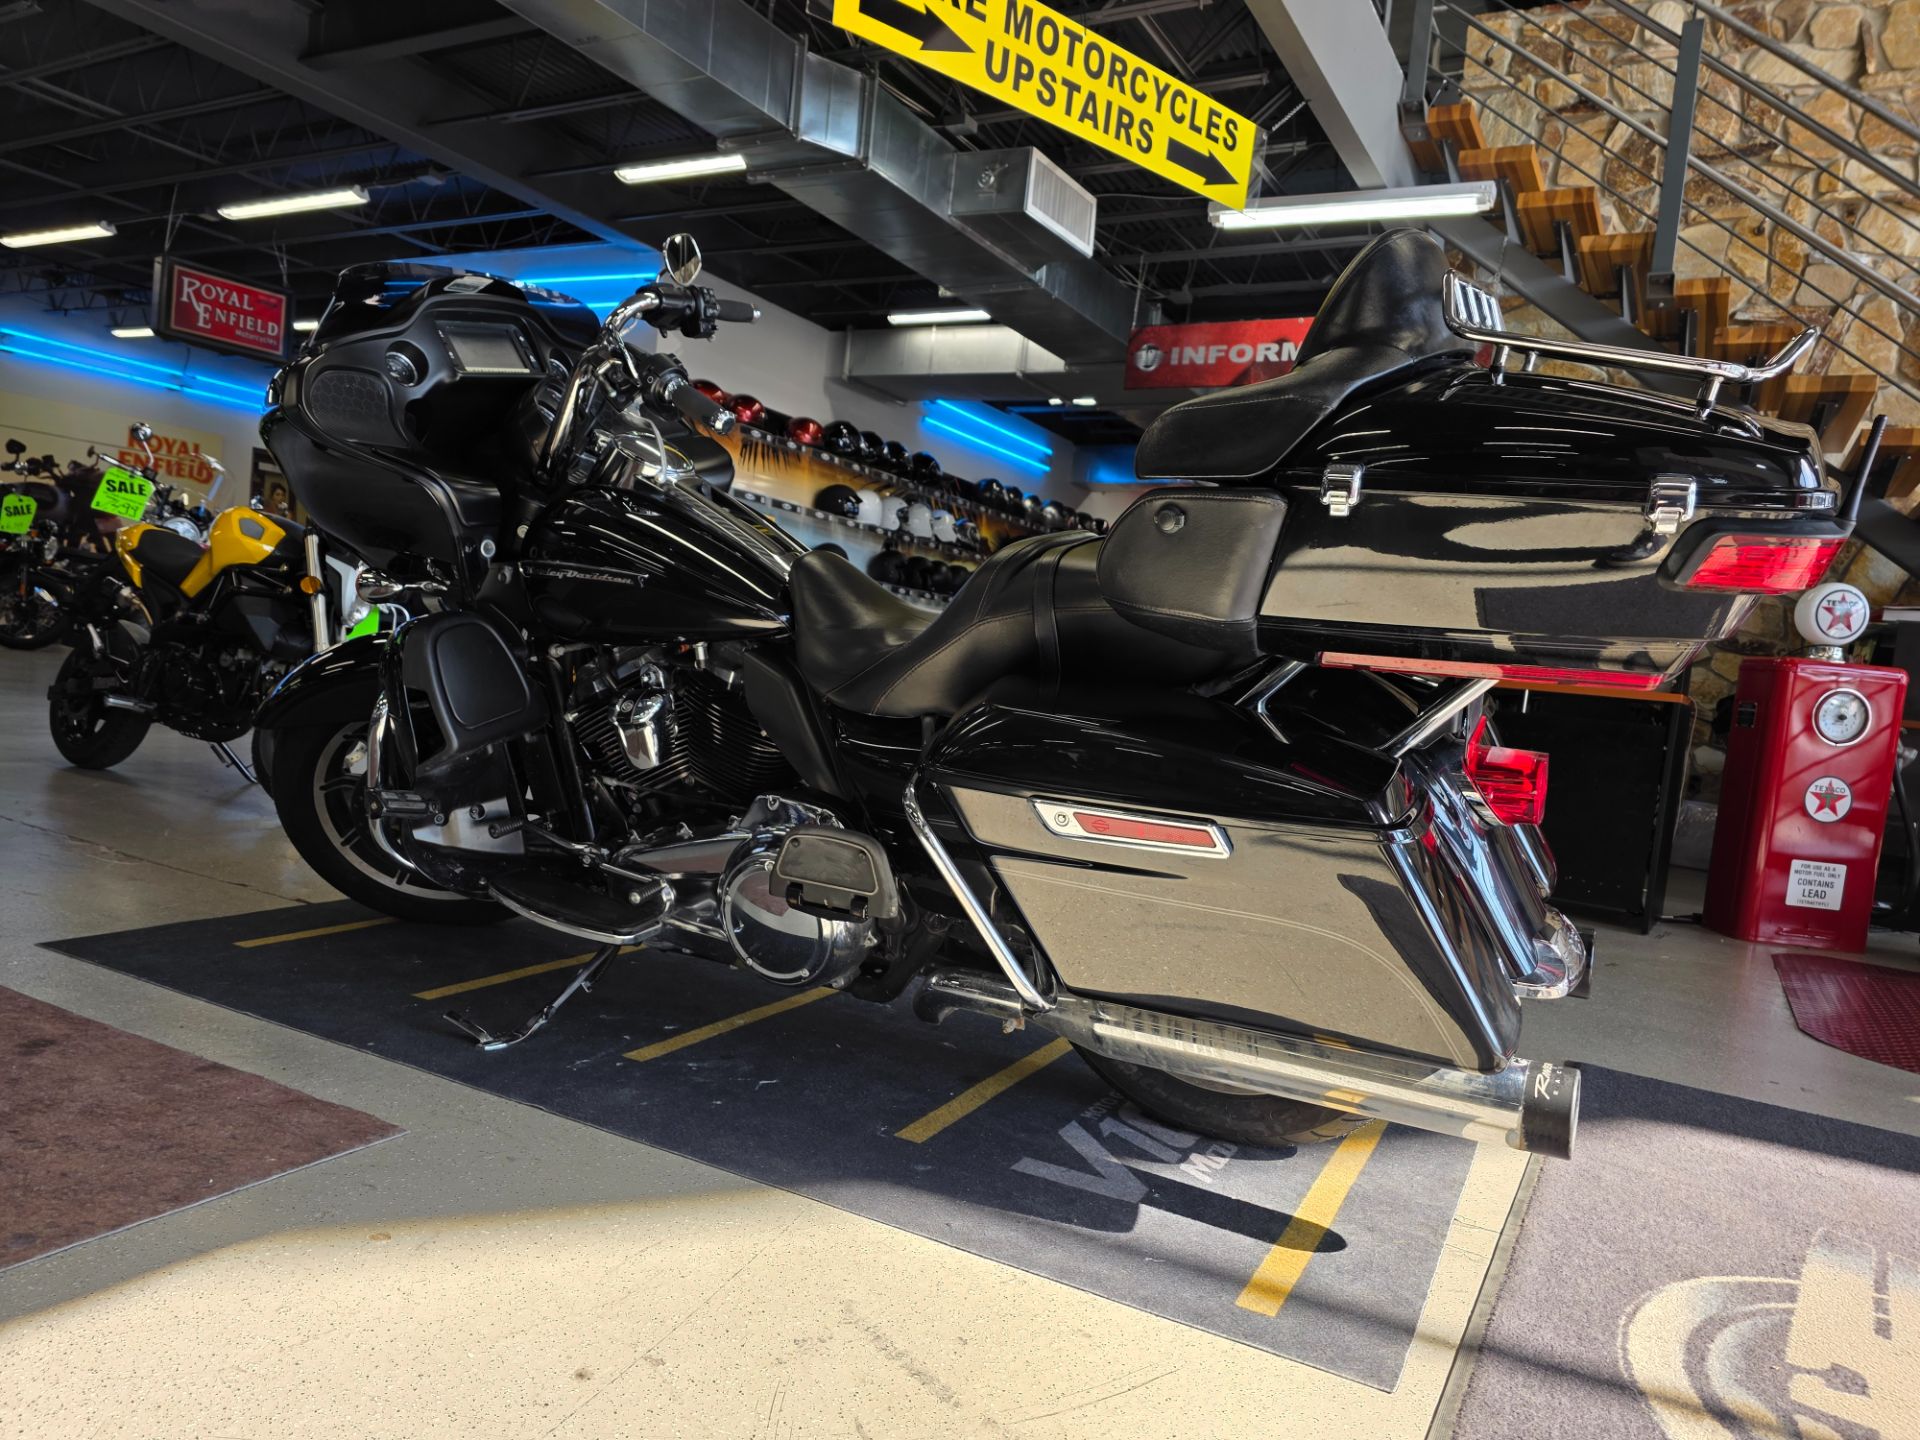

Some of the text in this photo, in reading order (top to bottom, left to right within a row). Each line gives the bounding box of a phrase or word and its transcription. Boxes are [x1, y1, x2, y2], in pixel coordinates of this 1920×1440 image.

[1004, 0, 1239, 152] MOTORCYCLES
[985, 39, 1154, 154] UPSTAIRS
[180, 276, 254, 312] ROYAL
[196, 302, 279, 336] ENFIELD
[105, 479, 147, 497] SALE
[4, 503, 32, 517] SALE
[1797, 878, 1835, 889] CONTAINS
[1802, 888, 1827, 899] LEAD
